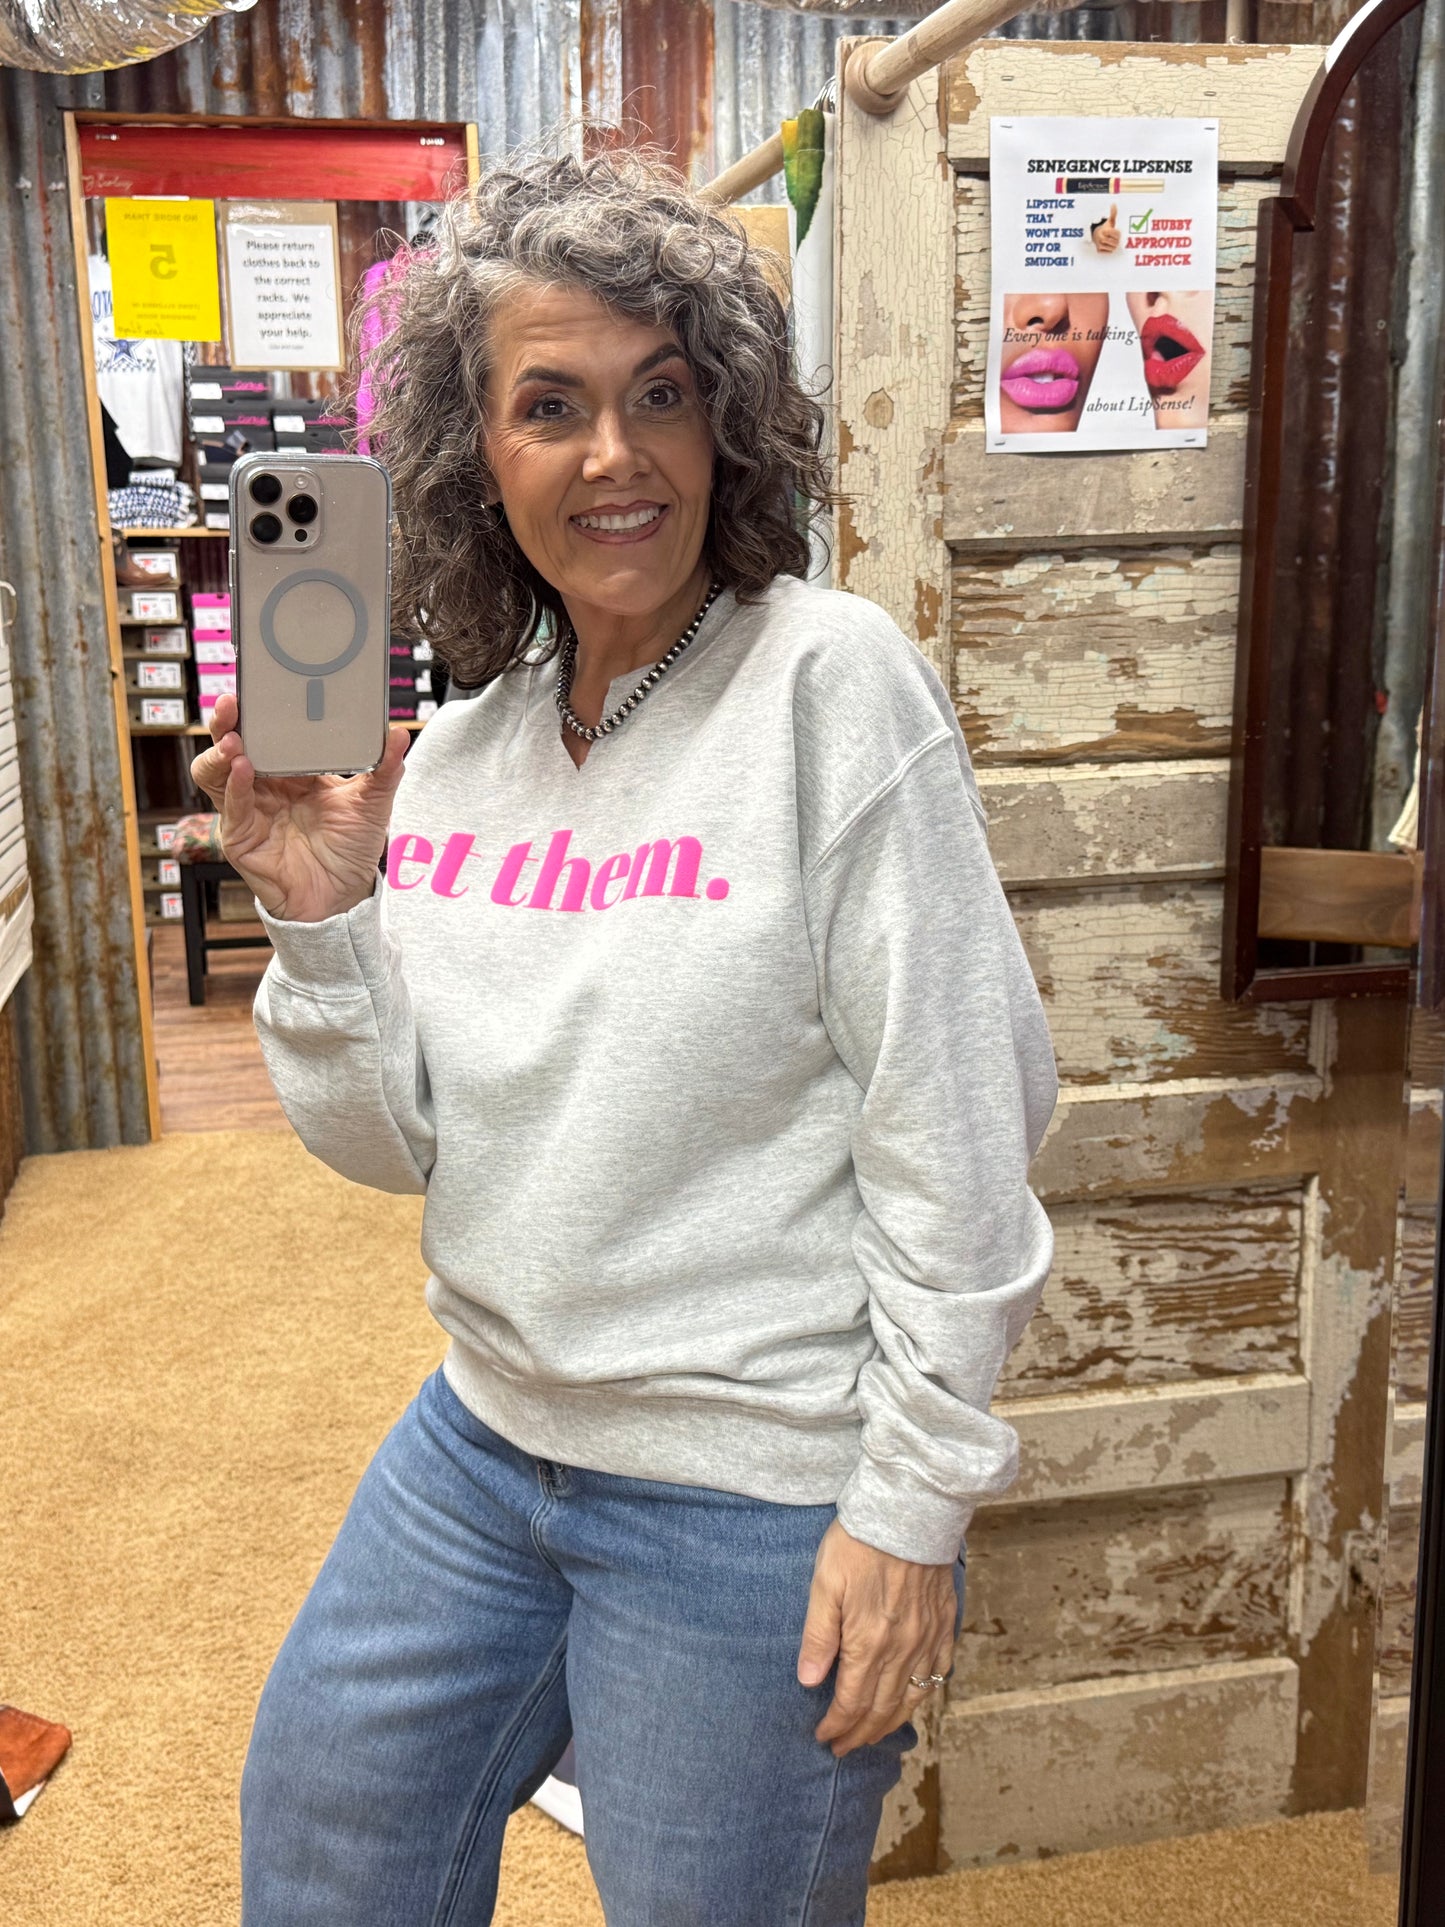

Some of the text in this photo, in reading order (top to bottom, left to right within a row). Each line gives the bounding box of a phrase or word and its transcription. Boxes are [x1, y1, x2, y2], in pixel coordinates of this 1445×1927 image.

[1027, 159, 1193, 173] SENEGENCE LIPSENSE
[1026, 199, 1075, 209] LIPSTICK
[1026, 213, 1054, 223] THAT
[1151, 218, 1192, 231] HUBBY
[1025, 228, 1084, 238] WON'T KISS
[247, 241, 314, 251] Please return
[1025, 242, 1061, 252] OFF OR
[1125, 236, 1192, 249] APPROVED
[243, 258, 321, 268] clothes back to
[1025, 256, 1069, 267] SMUDGE
[1135, 254, 1192, 267] LIPSTICK
[254, 276, 311, 286] the correct
[257, 294, 310, 303] racks. We
[258, 311, 312, 321] appreciate
[260, 328, 312, 339] your help.
[1071, 327, 1083, 341] is
[1086, 395, 1195, 417] about LipSense!
[386, 829, 730, 913] et them.
